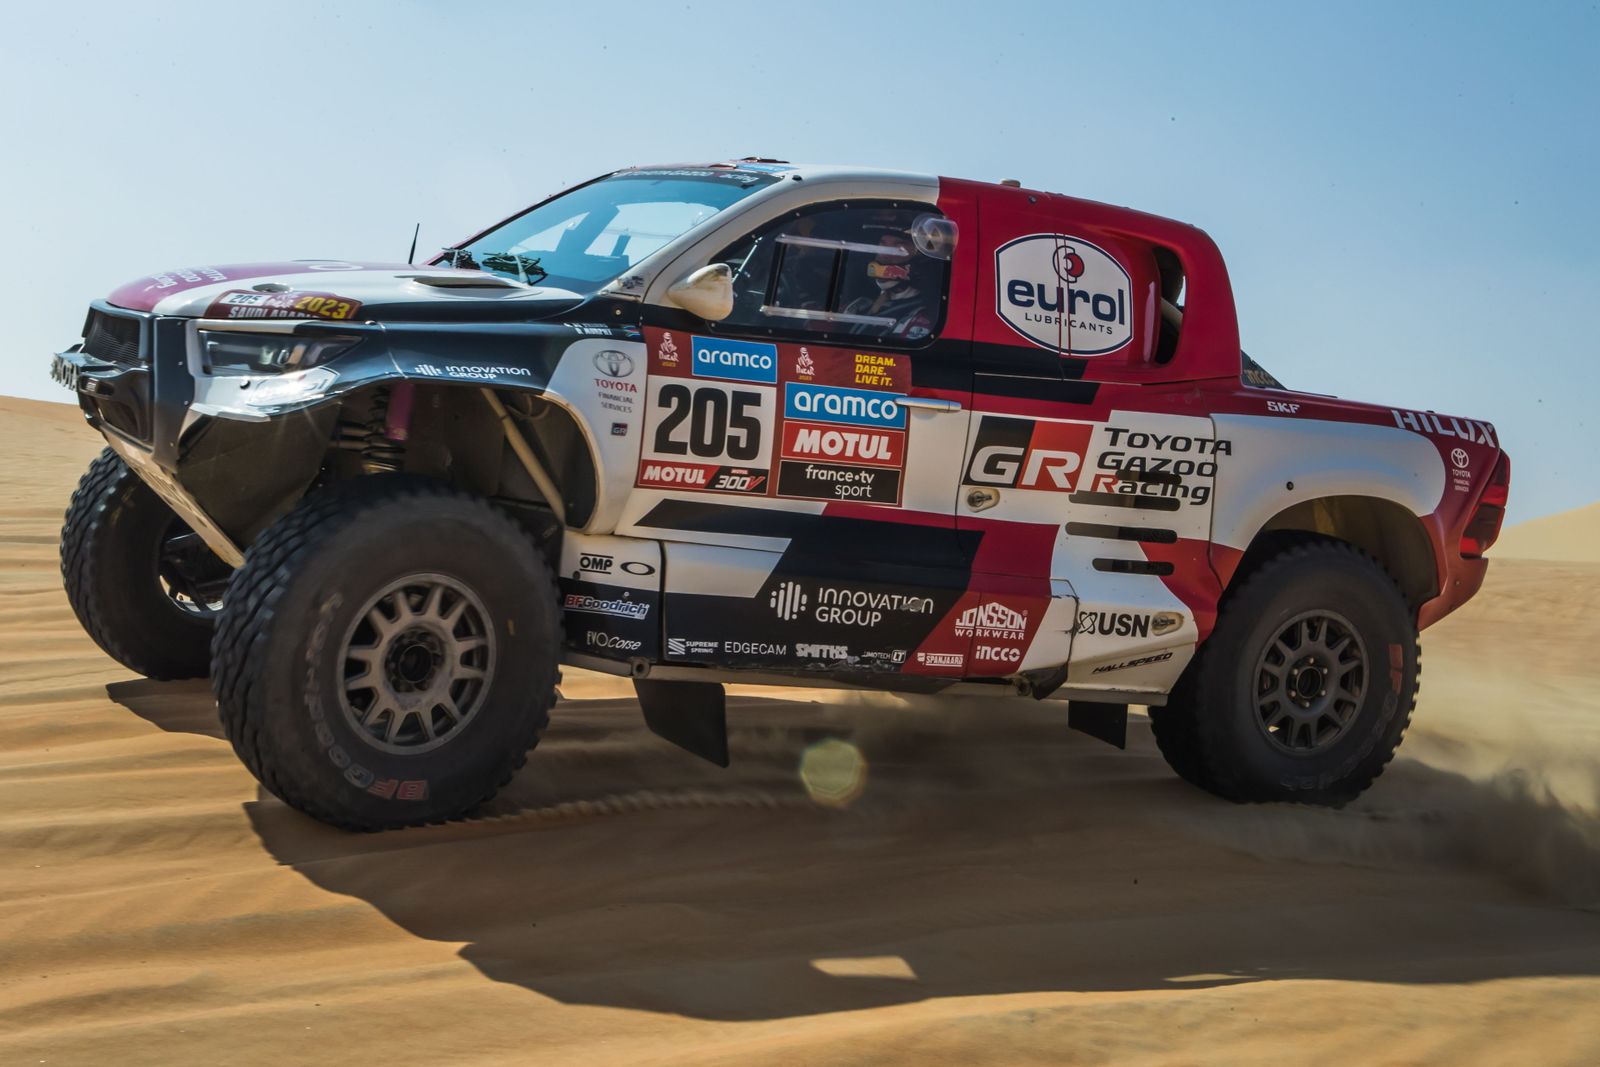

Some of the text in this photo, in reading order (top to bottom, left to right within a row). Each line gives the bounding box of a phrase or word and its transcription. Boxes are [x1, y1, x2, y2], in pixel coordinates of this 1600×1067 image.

[229, 294, 262, 304] 205
[294, 296, 350, 319] 2023
[1007, 279, 1125, 326] eurol
[1025, 312, 1113, 335] LUBRICANTS
[698, 349, 772, 369] aramco
[855, 354, 896, 367] DREAM.
[445, 365, 531, 376] INNOVATION
[449, 371, 497, 379] GROUP
[855, 364, 887, 376] DARE.
[594, 378, 638, 393] TOYOTA
[855, 374, 893, 387] LIVE IT.
[794, 391, 898, 420] aramco
[1267, 401, 1300, 414] SKF
[654, 384, 762, 461] 205
[1391, 409, 1496, 448] HILUX
[793, 429, 892, 460] MOTUL
[1104, 427, 1232, 456] TOYOTA
[969, 445, 1081, 489] GR
[1097, 451, 1218, 477] GAZOO
[1452, 468, 1471, 479] TOYOTA
[643, 466, 706, 484] MOTUL
[715, 475, 766, 490] 300V
[834, 484, 872, 498] sport
[1091, 473, 1211, 506] Racing
[579, 555, 613, 572] OMP
[565, 595, 648, 615] BFGoodrich
[815, 606, 882, 627] GROUP
[955, 602, 1028, 630] JONSSON
[1098, 612, 1151, 638] USN
[954, 628, 1026, 641] WORKWEAR
[724, 641, 787, 656] EDGECAM
[1091, 652, 1174, 675] HALLSPEED
